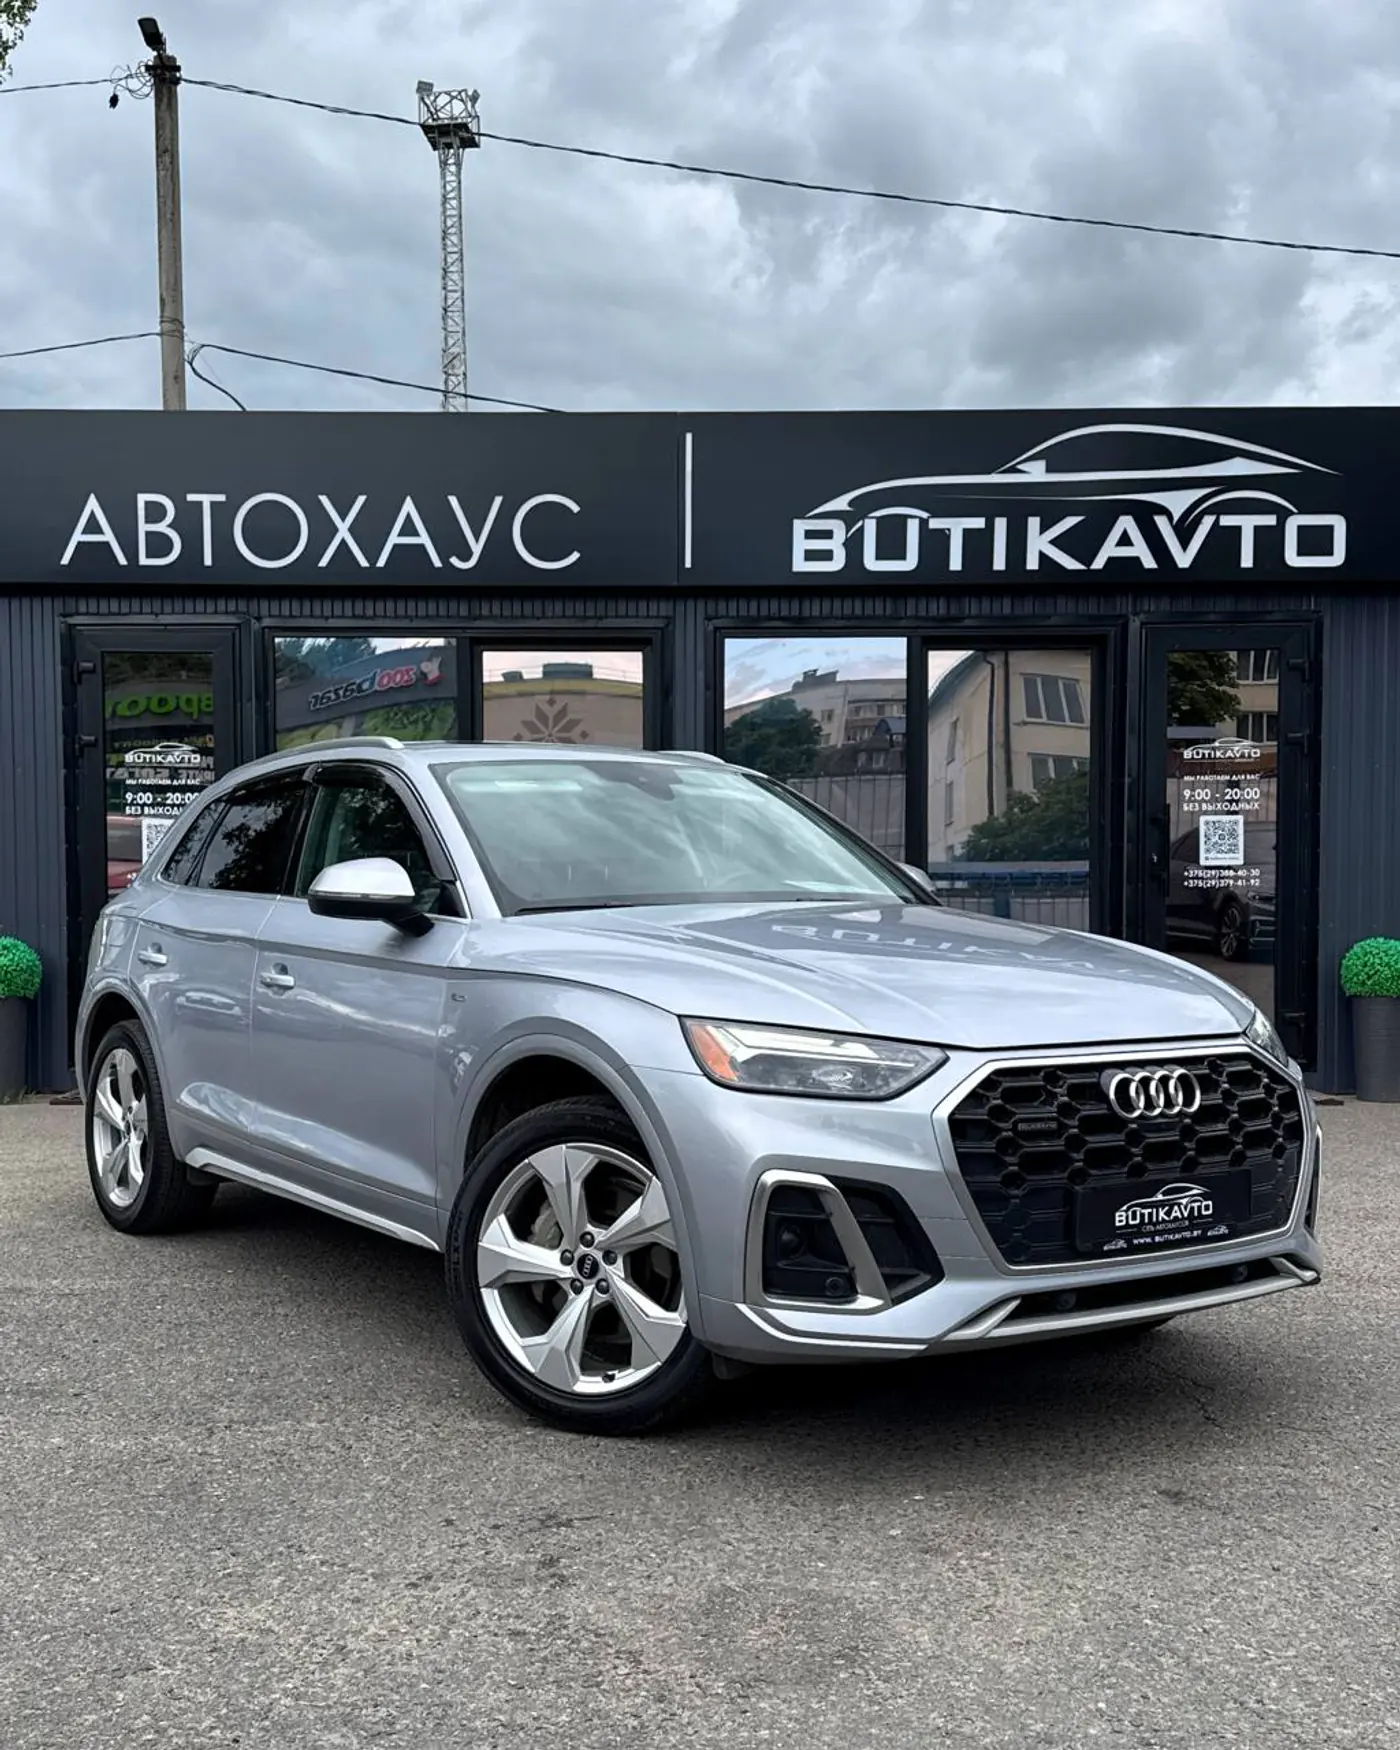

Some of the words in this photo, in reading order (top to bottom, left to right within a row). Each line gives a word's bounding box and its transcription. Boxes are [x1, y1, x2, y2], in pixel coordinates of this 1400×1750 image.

[60, 492, 582, 570] АВТОХАУС
[791, 513, 1347, 573] BUTIKAVTO
[124, 753, 201, 763] BUTIKAVTO
[1183, 749, 1260, 759] BUTIKAVTO
[125, 791, 153, 804] 9:00
[1183, 788, 1211, 801] 9:00
[1224, 787, 1260, 800] 20:00
[125, 805, 141, 815] БЕЗ
[143, 805, 183, 816] ВЫХОД
[1183, 802, 1199, 812] БЕЗ
[1201, 801, 1260, 811] ВЫХОДНЫХ
[1114, 1200, 1213, 1227] BUTIKAVTO
